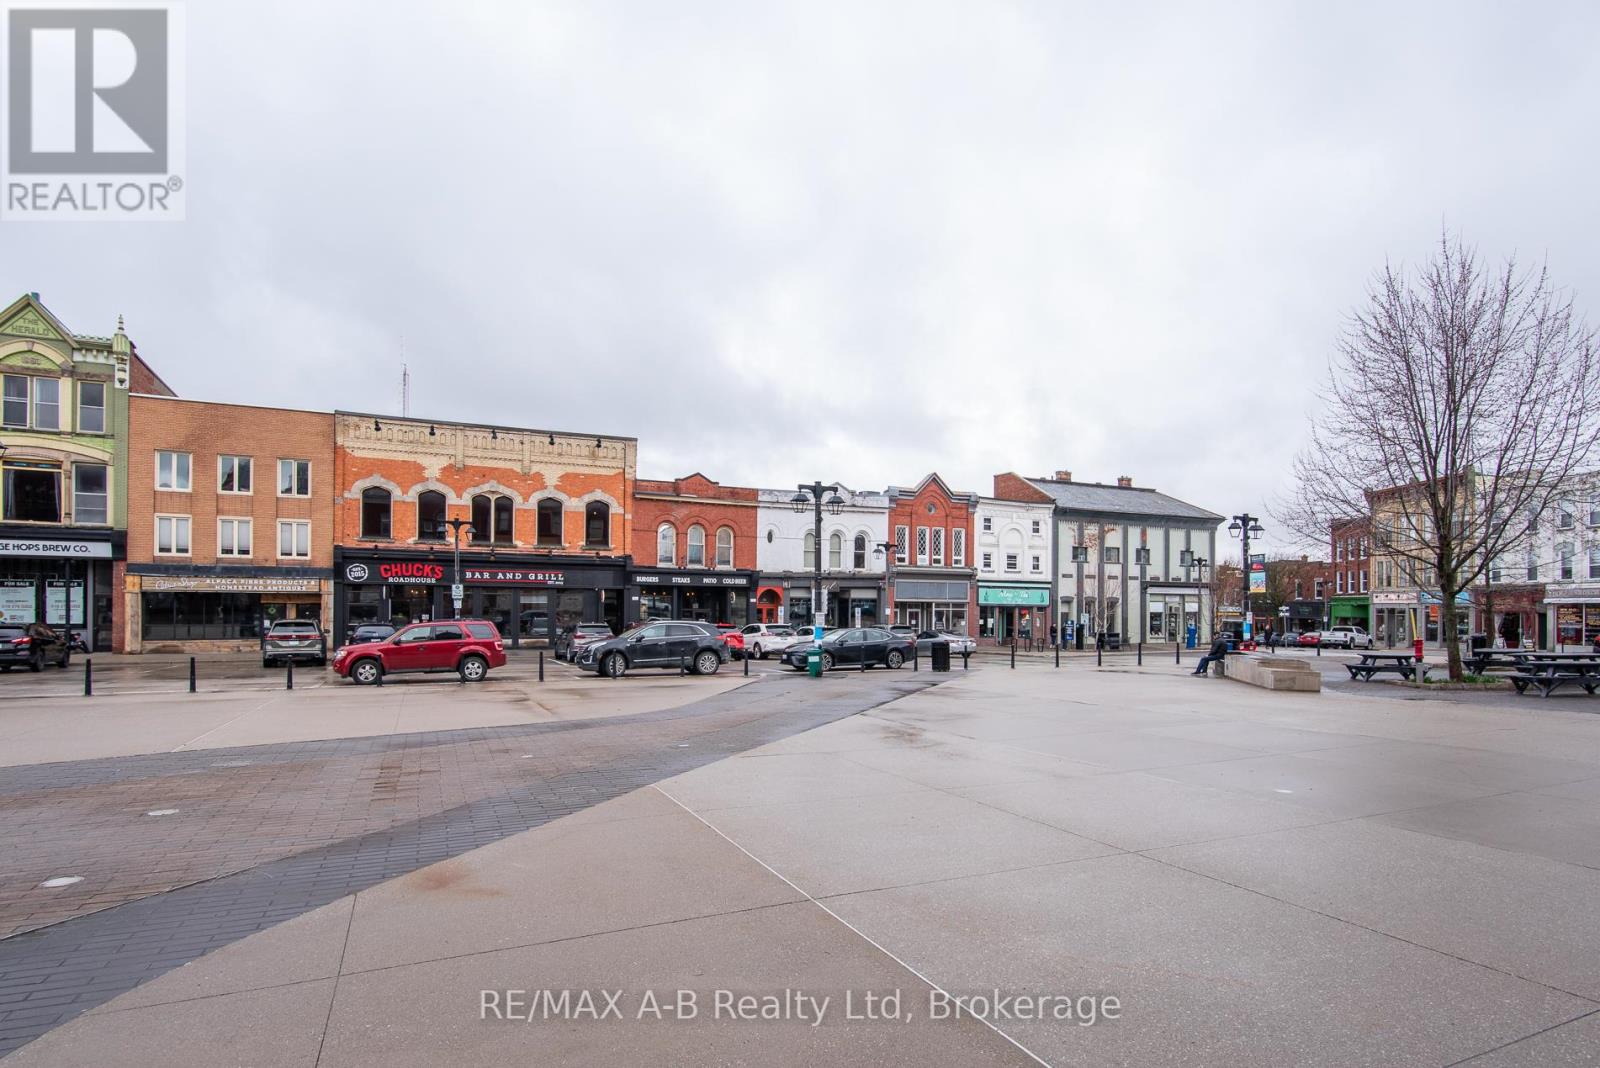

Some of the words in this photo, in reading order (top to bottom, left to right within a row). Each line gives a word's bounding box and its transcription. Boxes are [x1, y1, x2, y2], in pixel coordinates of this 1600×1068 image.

[22, 318, 39, 326] THE
[11, 325, 50, 336] HERALD
[12, 543, 40, 551] HOPS
[42, 544, 71, 552] BREW
[73, 545, 91, 553] CO.
[465, 571, 490, 579] BAR
[497, 572, 522, 580] AND
